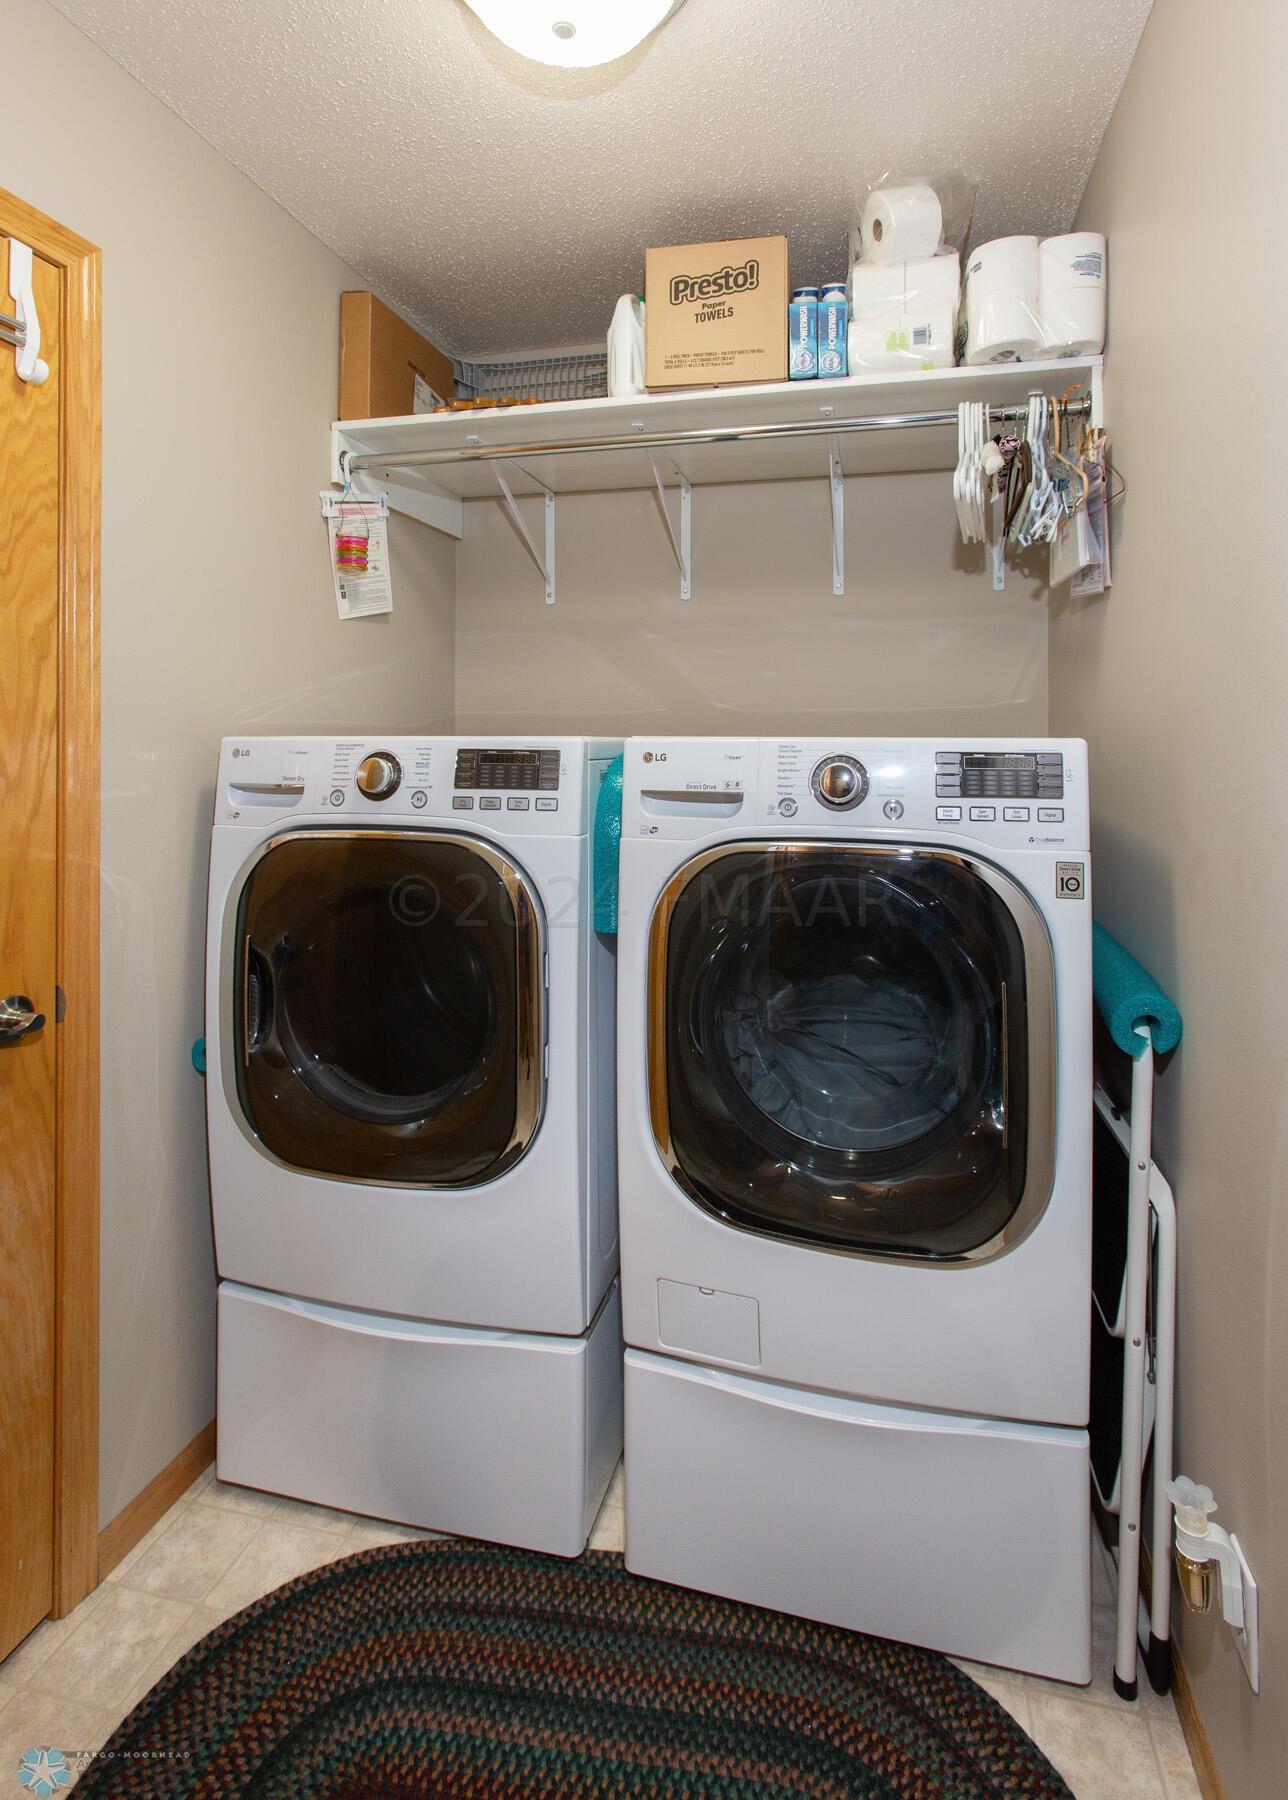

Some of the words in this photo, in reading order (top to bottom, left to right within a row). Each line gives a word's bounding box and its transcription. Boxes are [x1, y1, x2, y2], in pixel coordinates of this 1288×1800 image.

[671, 261, 758, 304] Presto!
[701, 300, 727, 311] Paper
[694, 306, 734, 324] TOWELS
[655, 753, 667, 762] LG
[1061, 876, 1080, 892] 10
